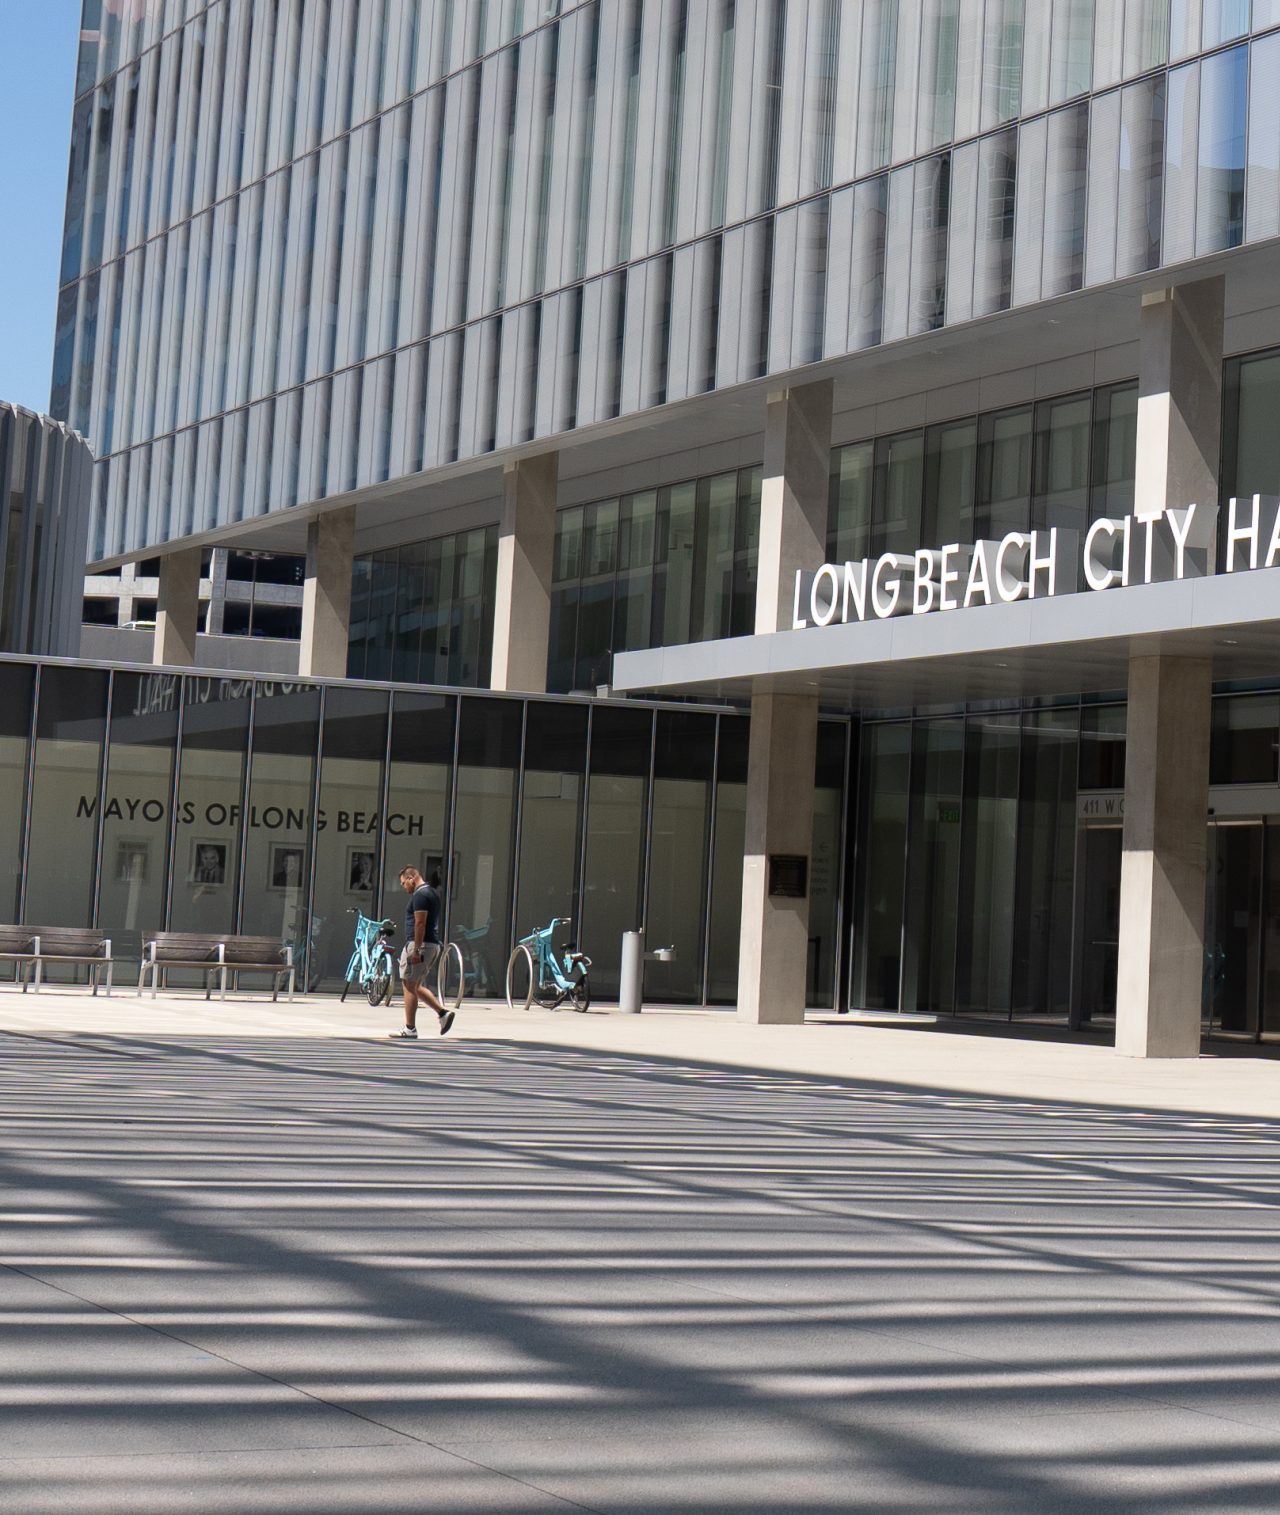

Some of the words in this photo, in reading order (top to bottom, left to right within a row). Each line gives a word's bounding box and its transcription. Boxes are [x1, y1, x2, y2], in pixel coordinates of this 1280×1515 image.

[792, 552, 900, 629] LONG
[912, 527, 1058, 614] BEACH
[1083, 504, 1197, 591] CITY
[205, 802, 240, 826] OF
[250, 806, 327, 832] LONG
[337, 810, 424, 836] BEACH
[1083, 799, 1099, 814] 411
[1105, 799, 1115, 814] W
